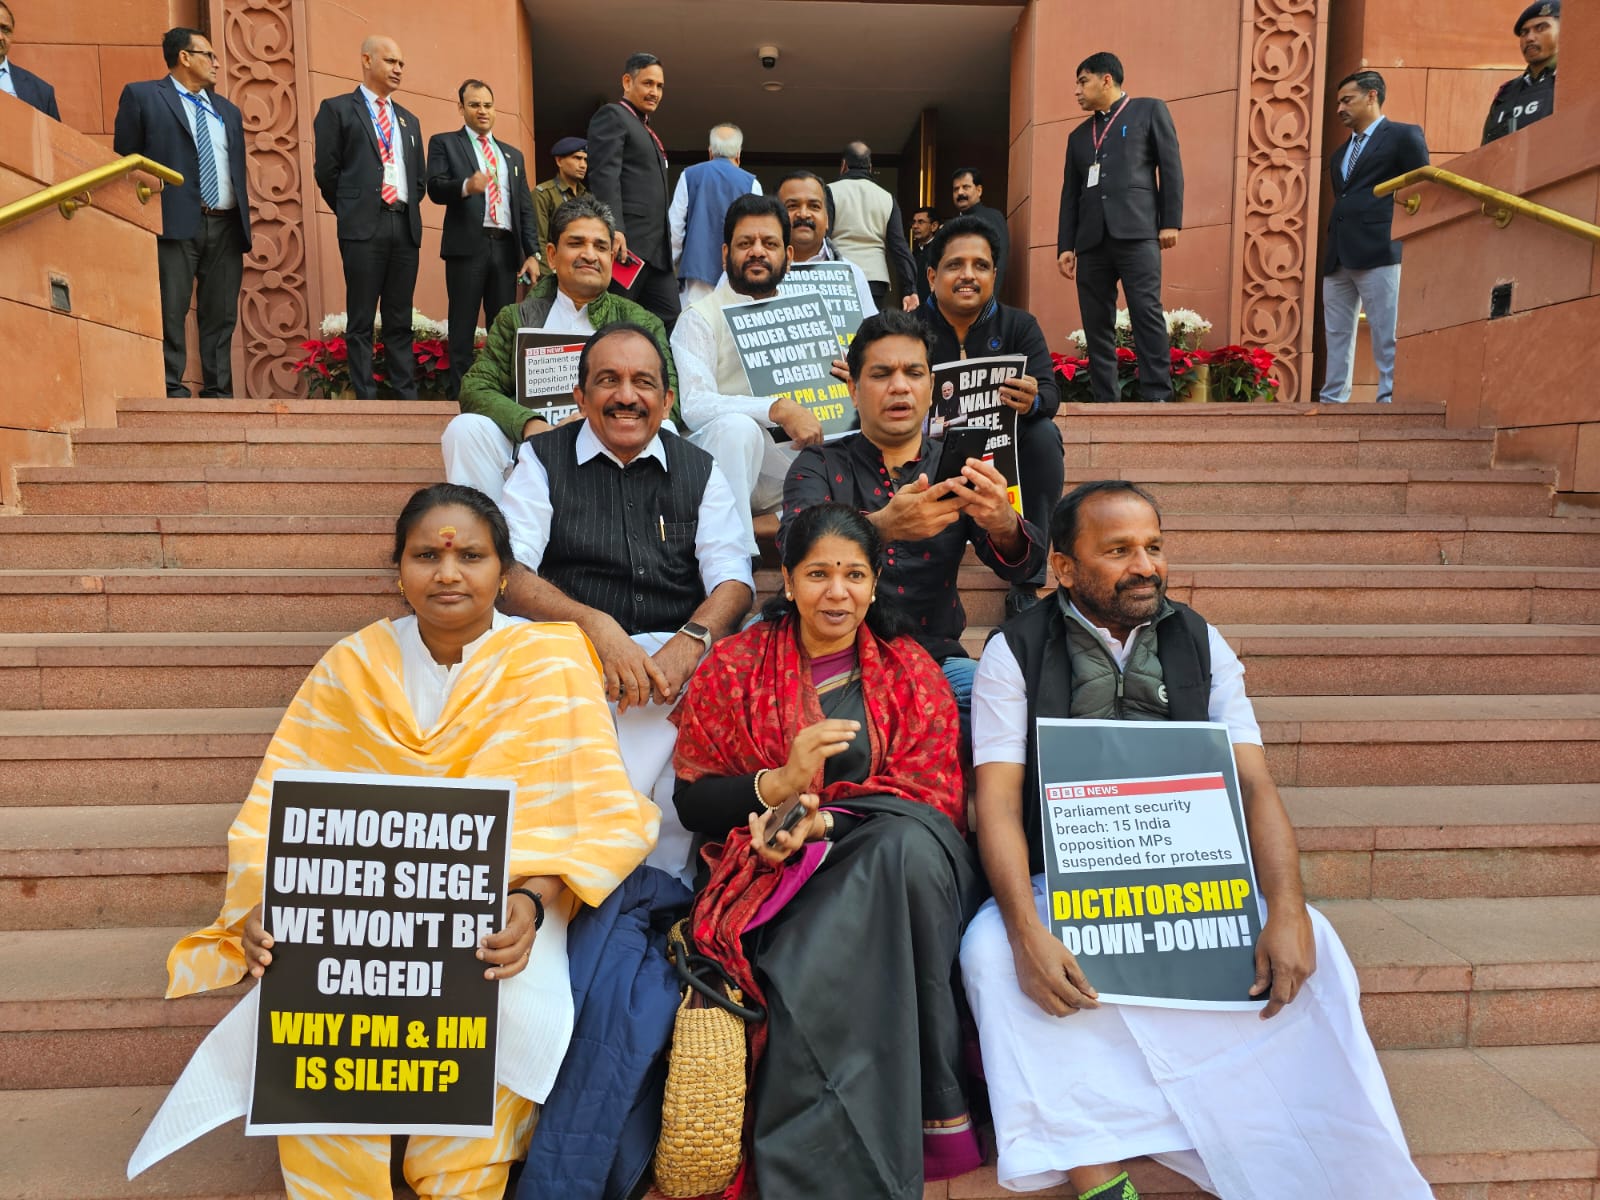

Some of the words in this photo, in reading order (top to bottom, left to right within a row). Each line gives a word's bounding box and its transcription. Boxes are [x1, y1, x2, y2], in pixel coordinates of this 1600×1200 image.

[783, 270, 850, 282] EMOCRACY
[819, 284, 857, 297] SIEGE,
[732, 302, 821, 331] DEMOCRACY
[843, 299, 860, 312] BE
[737, 328, 788, 350] UNDER
[787, 320, 833, 340] SIEGE,
[528, 355, 569, 366] Parliament
[743, 350, 771, 369] WE
[769, 342, 818, 365] WON'T
[818, 339, 839, 357] BE
[528, 367, 556, 376] breach:
[558, 365, 568, 373] 15
[528, 375, 568, 386] opposition
[772, 363, 826, 386] CAGED!
[959, 368, 988, 391] BJP
[528, 384, 570, 395] suspended
[794, 388, 817, 405] PM
[817, 388, 828, 401] &
[827, 383, 850, 400] HM
[959, 388, 1007, 414] WALK
[1087, 785, 1119, 796] NEWS
[1053, 802, 1131, 819] Parliament
[1134, 799, 1192, 816] security
[281, 806, 497, 852] DEMOCRACY
[1056, 820, 1110, 836] breach:
[1113, 819, 1131, 832] 15
[1135, 817, 1171, 831] India
[1059, 835, 1136, 855] opposition
[1138, 834, 1173, 848] MPs
[1062, 852, 1142, 871] suspended
[1145, 850, 1166, 865] for
[1171, 848, 1233, 866] protests
[273, 856, 386, 897] UNDER
[393, 860, 497, 905] SIEGE,
[1052, 878, 1251, 921] DICTATORSHIP
[270, 906, 325, 945] WE
[332, 908, 445, 948] WON'T
[452, 913, 495, 949] BE
[1061, 915, 1253, 957] DOWN-DOWN!
[317, 957, 444, 997] CAGED!
[270, 1010, 345, 1046] WHY
[350, 1013, 399, 1049] PM
[405, 1020, 431, 1049] &
[436, 1016, 487, 1049] HM
[295, 1056, 328, 1090] IS
[333, 1056, 460, 1093] SILENT?
